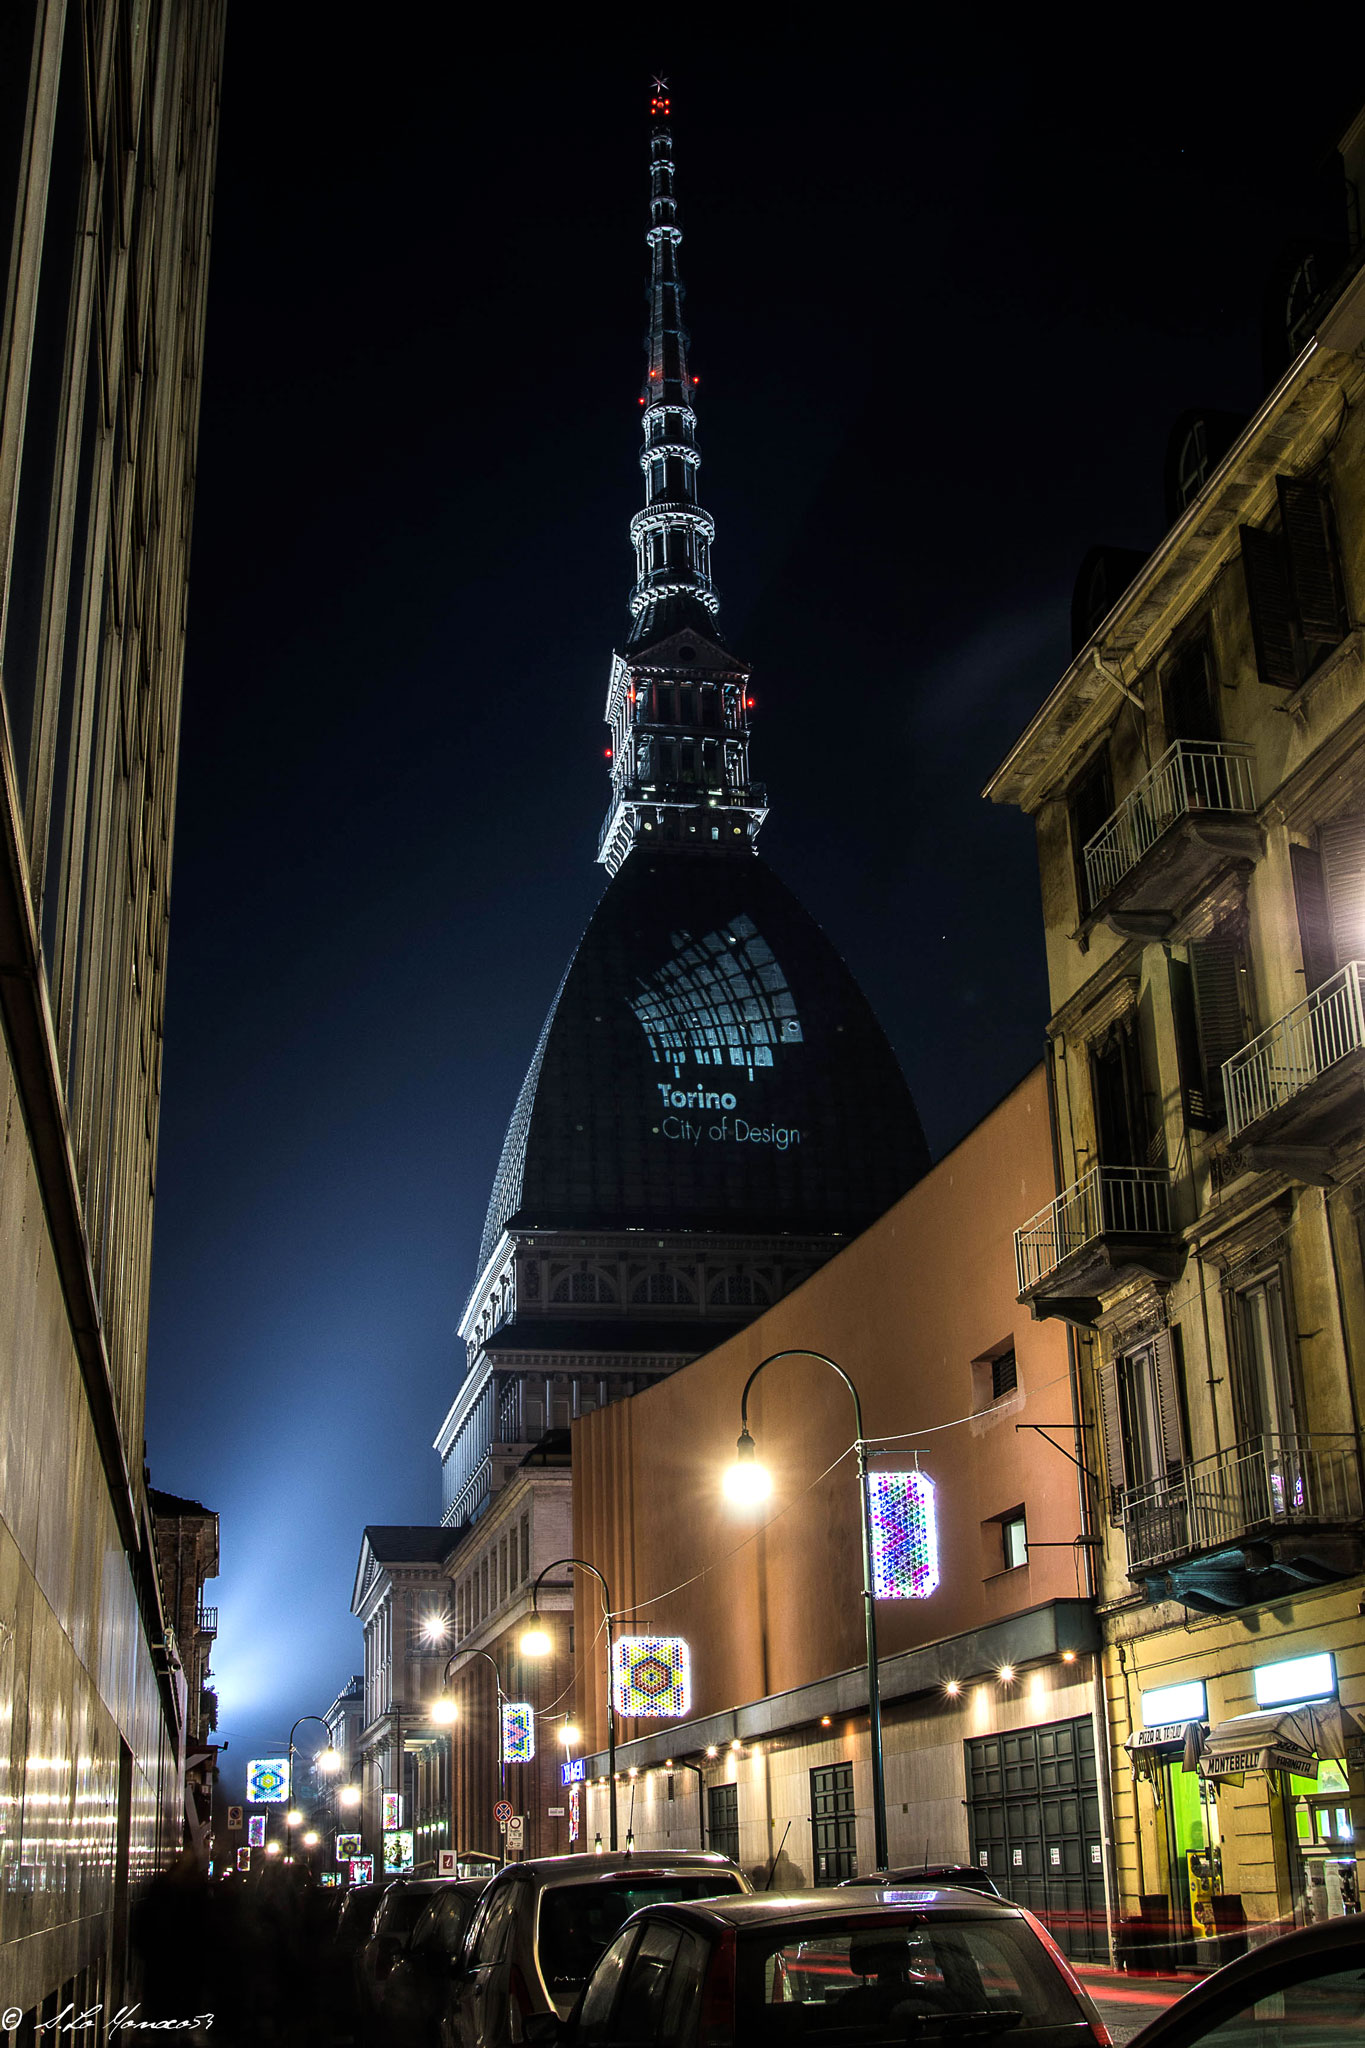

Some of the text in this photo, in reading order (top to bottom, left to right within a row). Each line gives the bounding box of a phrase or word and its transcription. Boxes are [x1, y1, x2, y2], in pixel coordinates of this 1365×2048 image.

[658, 1084, 736, 1110] Torino
[662, 1116, 800, 1150] City of Design
[1138, 1731, 1154, 1745] PIZZA
[1155, 1728, 1162, 1741] AL
[1207, 1752, 1260, 1774] MONTEBELLO
[1277, 1755, 1311, 1773] FARINATA
